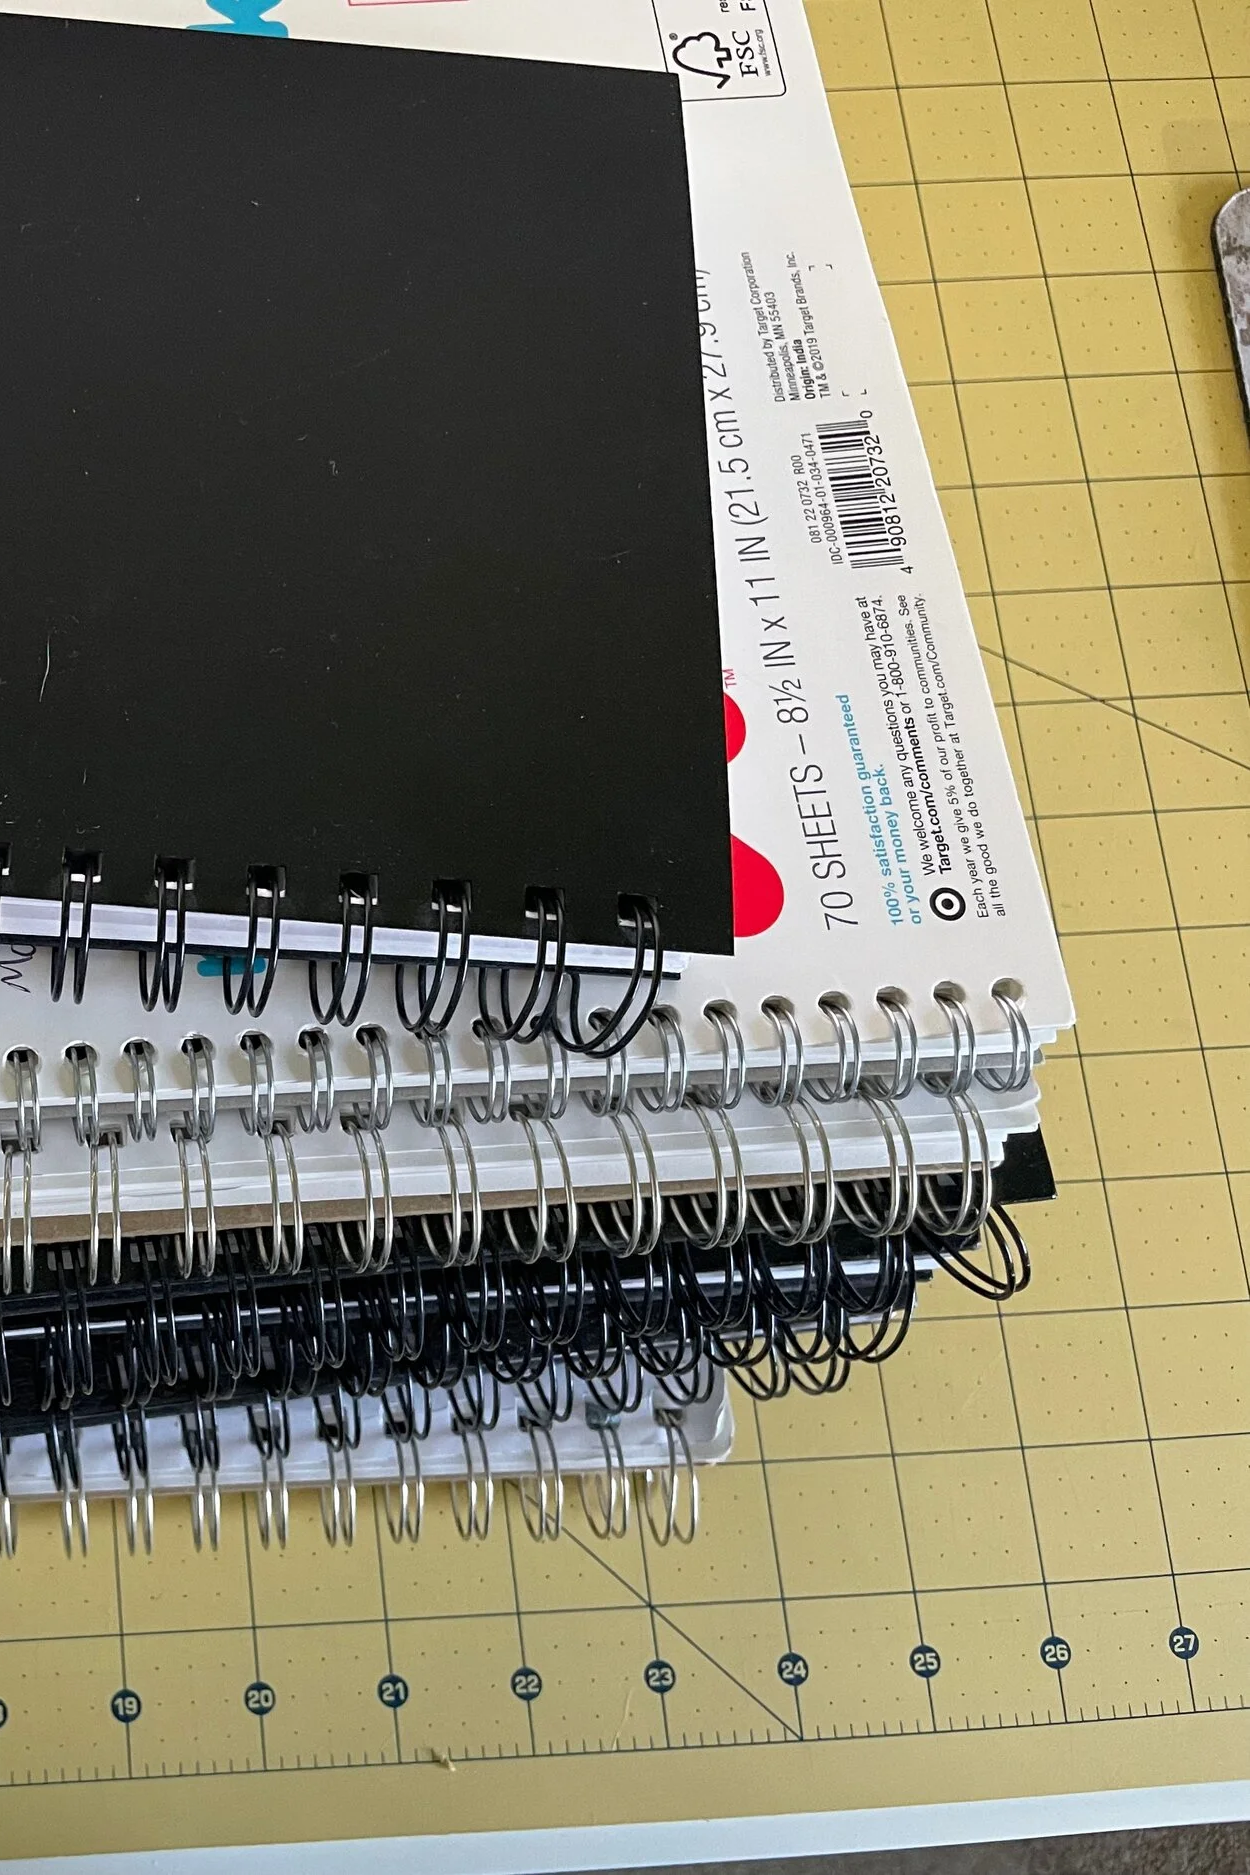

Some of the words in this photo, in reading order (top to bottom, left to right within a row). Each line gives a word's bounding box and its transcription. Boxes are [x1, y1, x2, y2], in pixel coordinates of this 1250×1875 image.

[732, 30, 759, 77] FSC
[754, 28, 772, 77] www.fsc.org
[786, 252, 797, 268] Inc.
[741, 251, 762, 305] Corporation
[791, 270, 807, 305] Brands,
[764, 291, 781, 322] 55403
[799, 306, 815, 336] Target
[753, 307, 769, 336] Target
[774, 323, 785, 340] MN
[762, 338, 774, 350] by
[793, 339, 807, 364] India
[763, 352, 786, 402] Distributed
[778, 342, 801, 401] Minneapolis,
[800, 366, 815, 400] Origin:
[816, 373, 827, 381] &
[818, 383, 831, 399] TM
[713, 410, 743, 448] cm
[859, 410, 873, 419] 0
[864, 435, 891, 487] 20732
[718, 458, 769, 526] (21.5
[797, 480, 813, 506] 0732
[800, 433, 844, 564] IDC-000964-01-034-0471
[803, 508, 816, 522] 22
[879, 493, 907, 546] 90812
[808, 524, 822, 544] 081
[734, 536, 770, 562] IN
[900, 566, 913, 574] 4
[744, 577, 780, 606] 11
[855, 596, 868, 608] at
[898, 594, 910, 616] See
[861, 612, 877, 641] have
[759, 641, 796, 668] IN
[869, 643, 884, 670] may
[871, 594, 906, 698] 1-800-910-6874.
[905, 619, 930, 694] communities.
[913, 593, 956, 729] Target.com/Community.
[721, 668, 738, 690] TM
[877, 674, 895, 697] you
[901, 702, 912, 714] or
[924, 698, 934, 709] to
[835, 694, 871, 781] guaranteed
[883, 699, 909, 761] questions
[926, 713, 945, 743] profit
[949, 732, 960, 744] at
[938, 746, 949, 766] our
[872, 763, 893, 806] back.
[900, 764, 914, 788] any
[941, 768, 953, 781] of
[953, 748, 974, 797] together
[903, 717, 952, 875] Target.com/comments
[945, 785, 959, 805] 5%
[967, 802, 979, 817] do
[790, 763, 846, 880] SHEETS
[862, 785, 892, 877] satisfaction
[906, 791, 929, 851] welcome
[953, 809, 969, 833] give
[974, 822, 986, 839] we
[885, 810, 907, 864] money
[961, 838, 974, 855] we
[921, 854, 936, 876] We
[965, 859, 983, 885] year
[978, 844, 997, 874] good
[898, 868, 920, 904] your
[988, 879, 1001, 898] the
[820, 891, 858, 930] 70
[882, 881, 904, 926] 100%
[909, 907, 922, 925] or
[972, 888, 989, 918] Each
[992, 903, 1006, 917] all
[114, 1696, 138, 1716] 19
[247, 1689, 273, 1709] 20
[381, 1682, 405, 1701] 21
[514, 1674, 539, 1694] 22
[648, 1667, 673, 1687] 23
[781, 1660, 807, 1679] 24
[913, 1652, 938, 1671] 25
[1044, 1643, 1069, 1663] 26
[1172, 1633, 1196, 1653] 27
